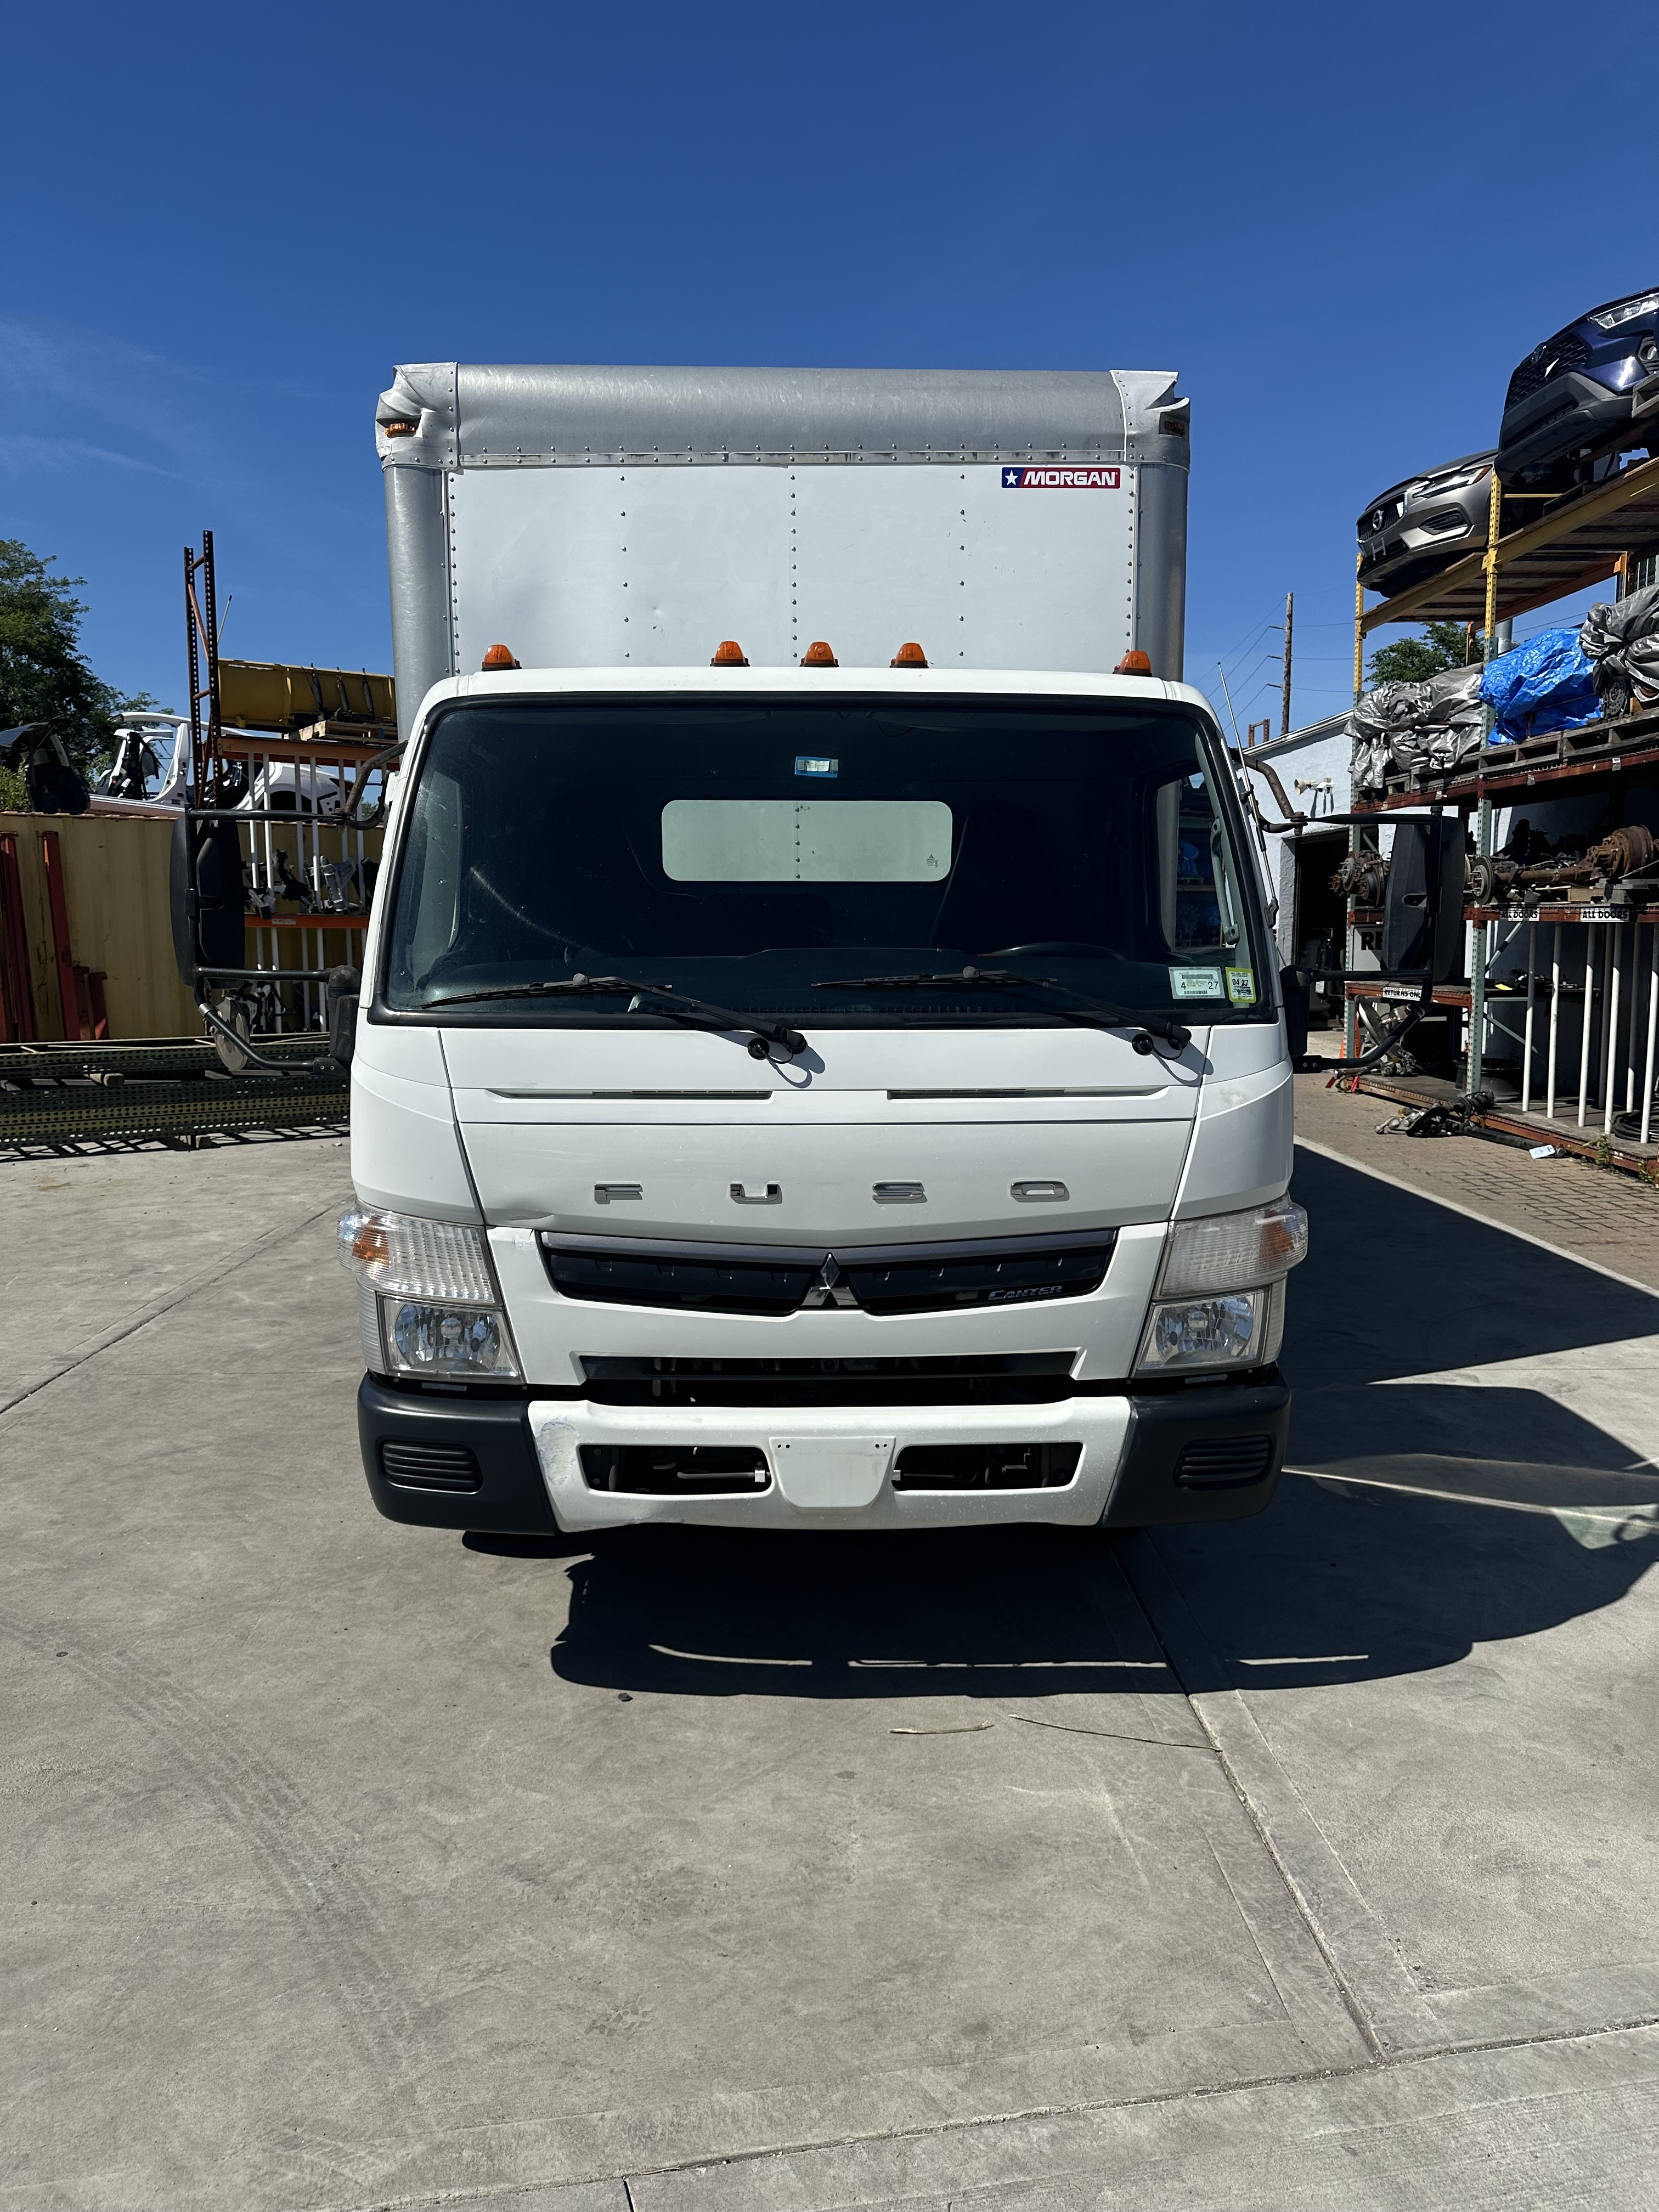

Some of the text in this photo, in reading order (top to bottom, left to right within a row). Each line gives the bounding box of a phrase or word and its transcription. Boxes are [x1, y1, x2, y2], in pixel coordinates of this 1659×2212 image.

[1024, 471, 1115, 486] MORGAN
[1181, 981, 1187, 990] 4
[1207, 981, 1218, 990] 27
[594, 1181, 1065, 1201] FUSO
[989, 1285, 1062, 1301] CANTER
